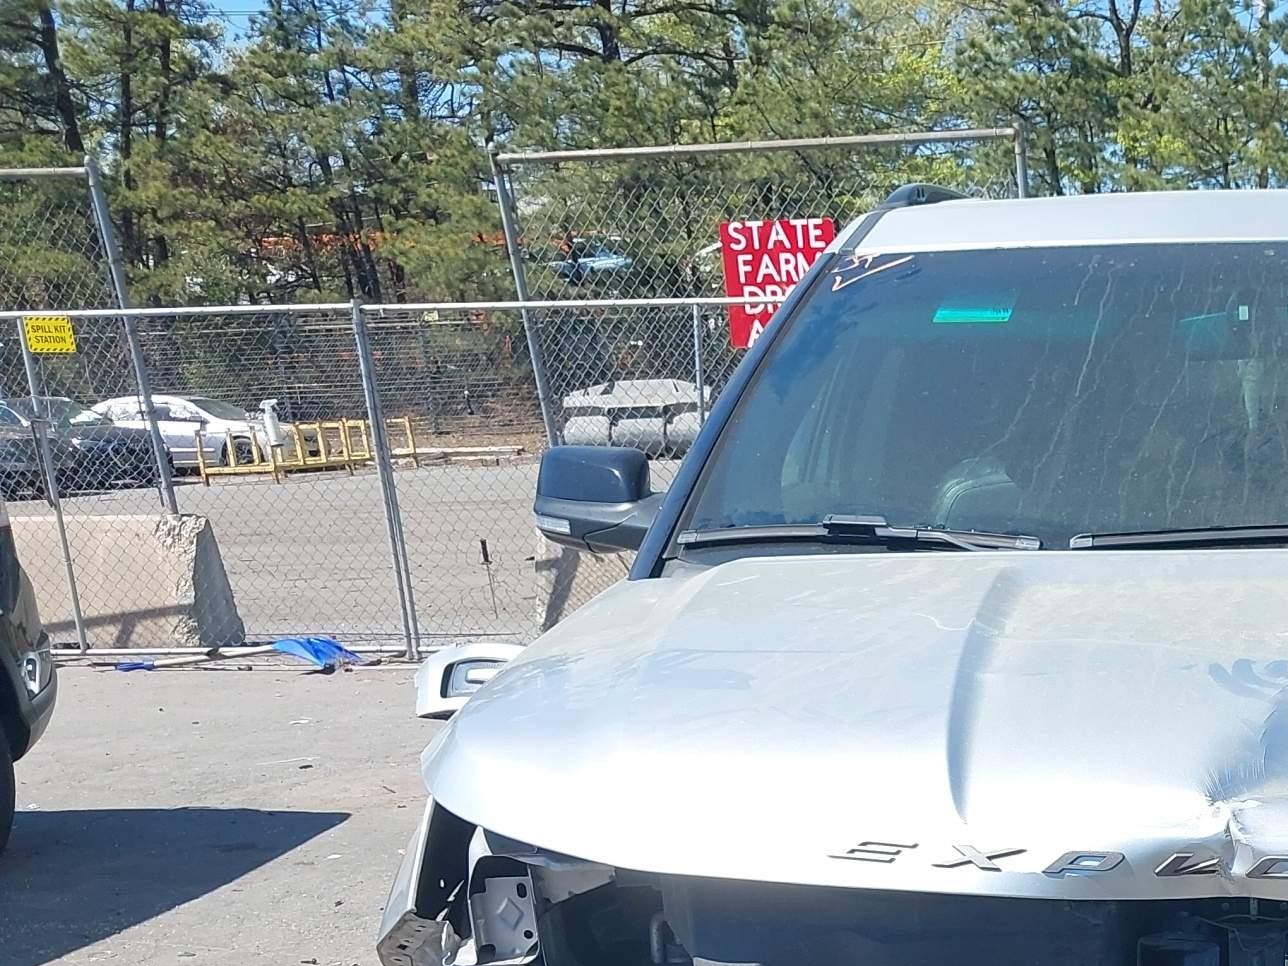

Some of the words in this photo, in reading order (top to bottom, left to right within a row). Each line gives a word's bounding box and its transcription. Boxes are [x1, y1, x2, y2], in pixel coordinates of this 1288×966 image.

[727, 219, 826, 251] STATE
[31, 324, 54, 334] SPILL
[54, 325, 67, 334] KIT
[34, 335, 67, 345] STATION
